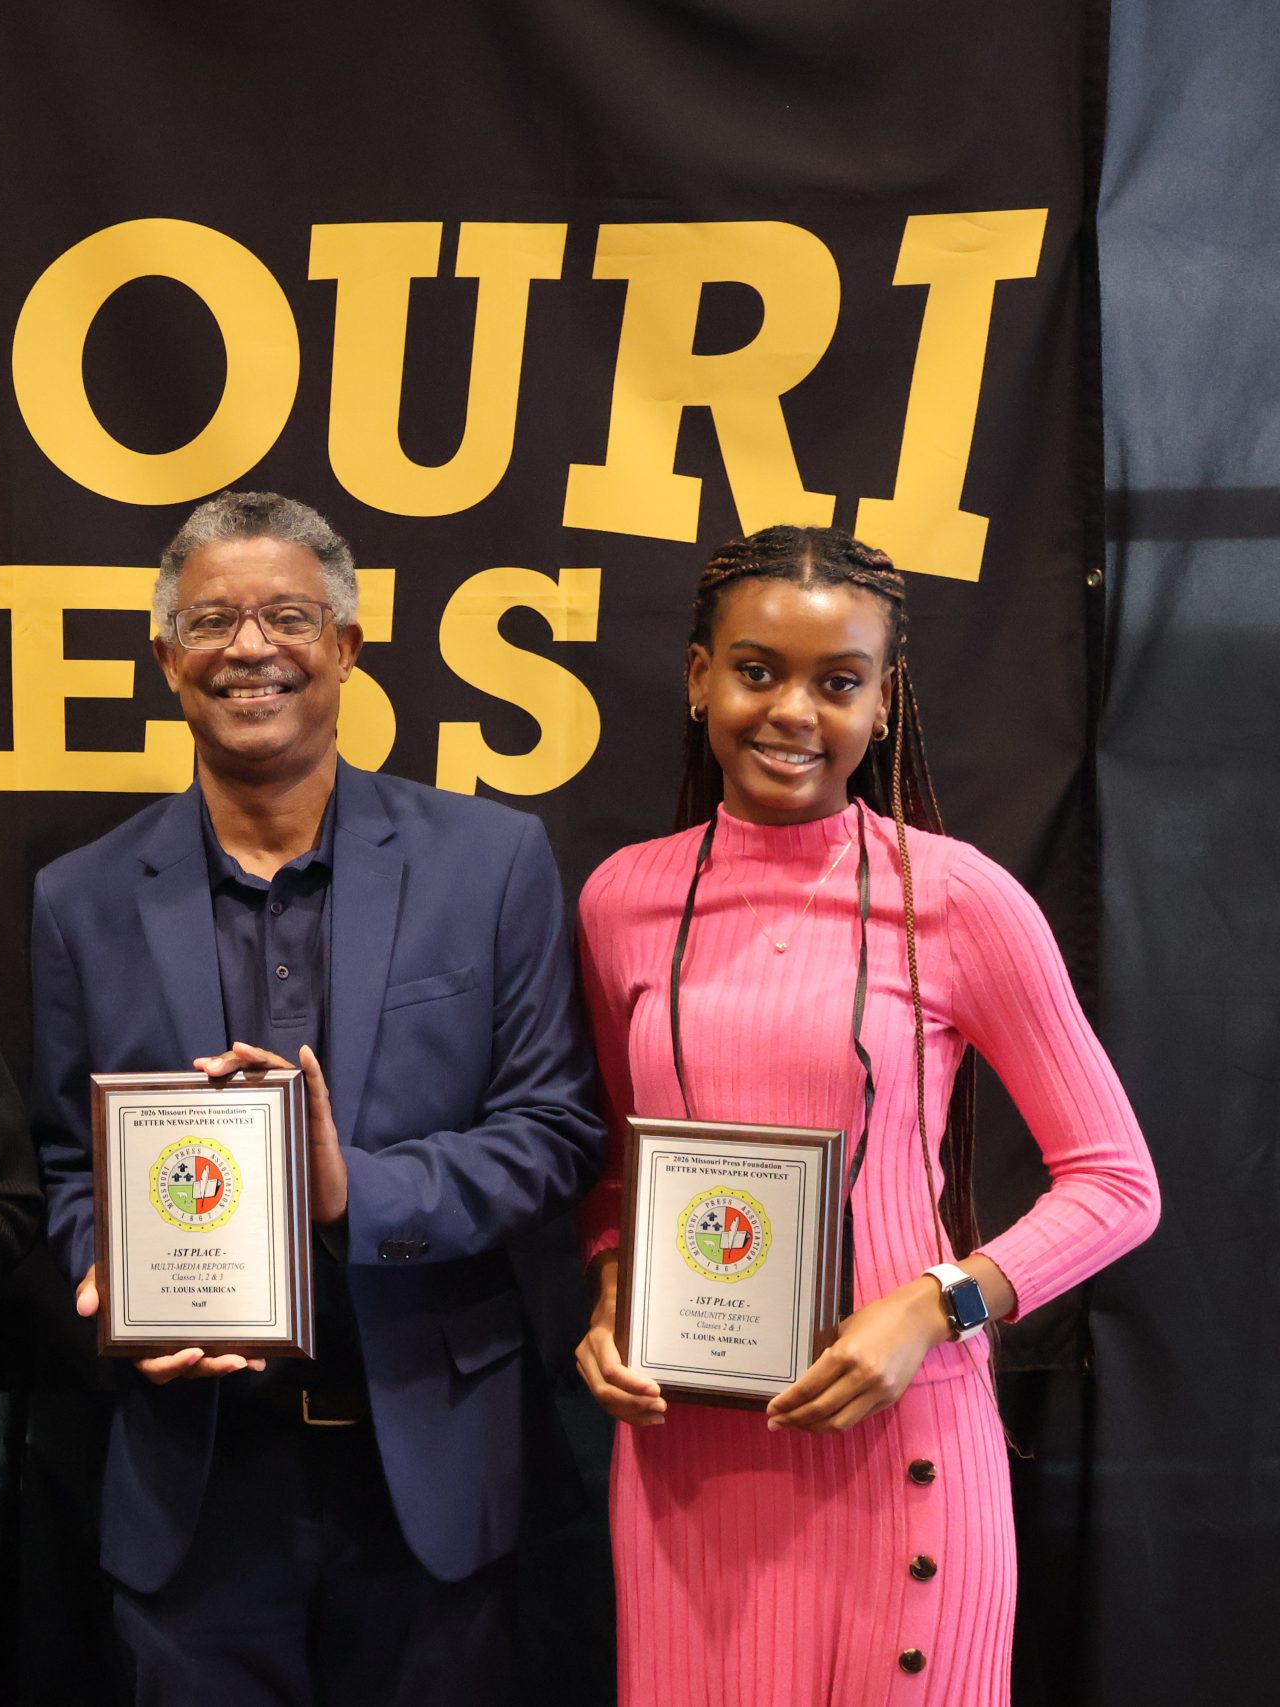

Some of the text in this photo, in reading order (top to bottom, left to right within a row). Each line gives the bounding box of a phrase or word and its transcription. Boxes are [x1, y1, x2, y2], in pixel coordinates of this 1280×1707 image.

[133, 1119, 164, 1127] BETTER
[166, 1118, 215, 1126] NEWSPAPER
[673, 1155, 782, 1170] 2026 Missouri Press Foundation
[160, 1148, 232, 1209] MISSOURI PRESS ASSOCIATION
[665, 1165, 789, 1181] BETTER NEWSPAPER CONTEST
[687, 1198, 761, 1261] MISSOURI PRESS ASSOCIATION
[173, 1248, 189, 1257] 1ST
[190, 1248, 221, 1257] PLACE
[150, 1263, 245, 1271] MULTI-MEDIA REPORTING
[171, 1273, 196, 1281] Classes
[205, 1273, 210, 1281] 2
[211, 1273, 217, 1281] &
[219, 1273, 224, 1281] 3
[161, 1286, 172, 1294] ST.
[191, 1300, 207, 1308] Staff
[696, 1296, 713, 1305] 1ST
[713, 1297, 745, 1308] PLACE
[679, 1309, 760, 1323] COMMUNITY SERVICE
[696, 1321, 721, 1330] Classes
[722, 1323, 727, 1331] 2
[693, 1333, 716, 1342] LOUIS
[717, 1336, 757, 1346] AMERICAN
